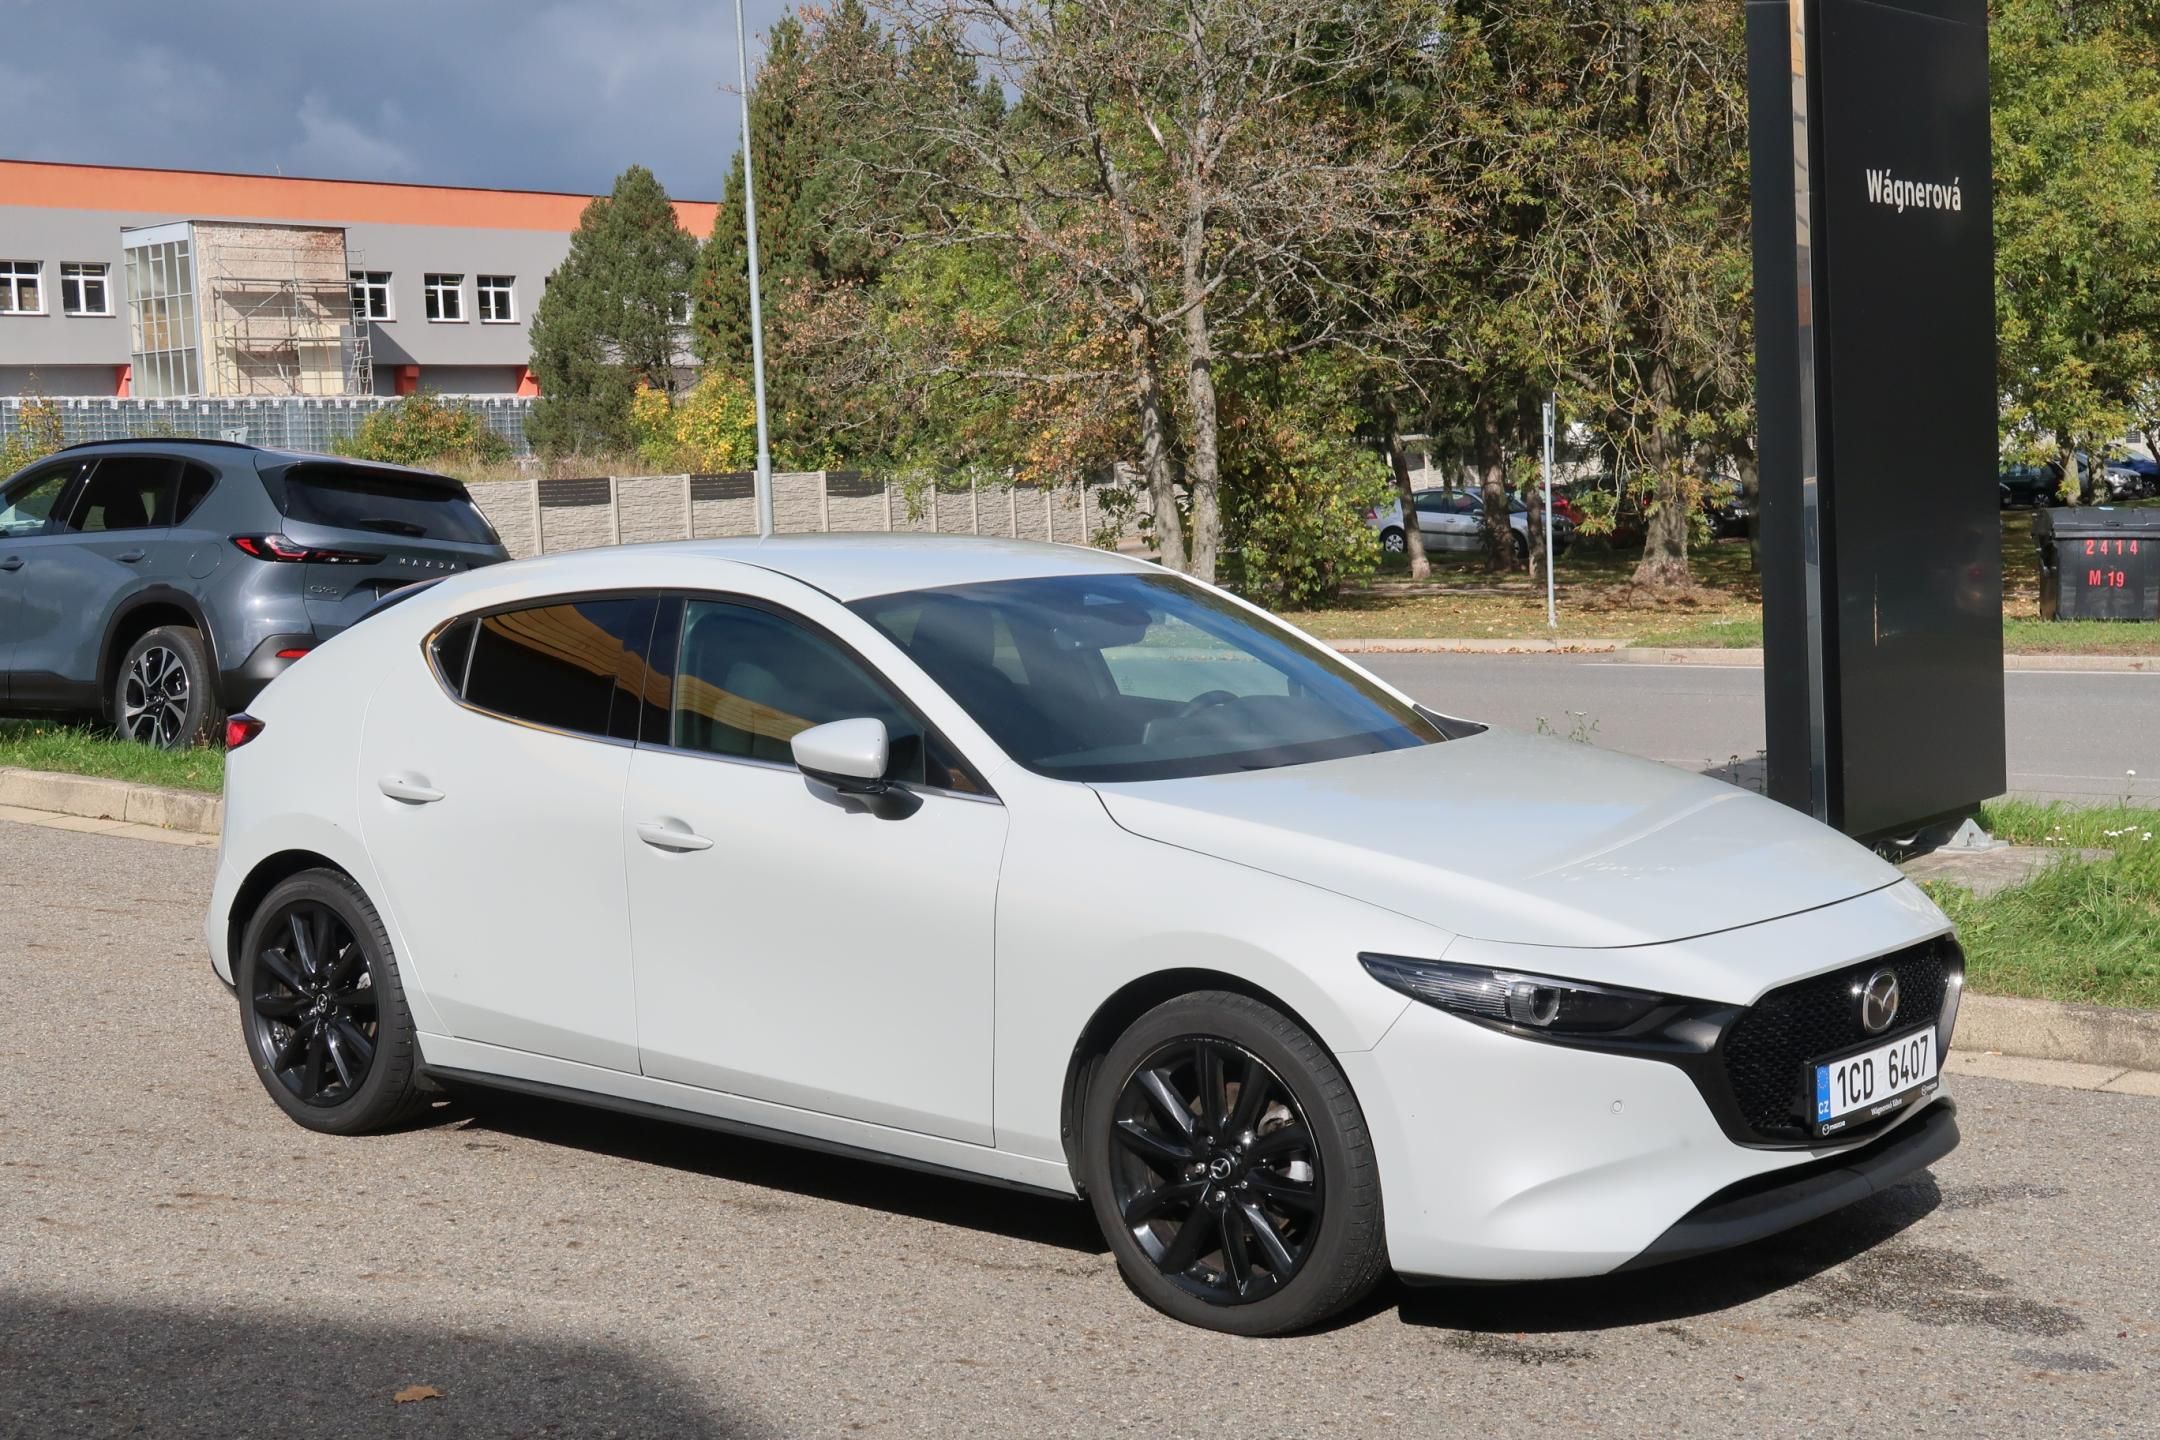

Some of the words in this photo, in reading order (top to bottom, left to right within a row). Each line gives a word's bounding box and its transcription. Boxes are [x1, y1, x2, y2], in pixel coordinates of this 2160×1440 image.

[1866, 168, 1961, 213] Wágnerová
[2086, 539, 2138, 555] 2414
[399, 557, 456, 570] MAZDA
[2089, 569, 2102, 586] M
[2108, 571, 2124, 587] 19
[1837, 1058, 1874, 1108] 1CD
[1888, 1035, 1928, 1089] 6407
[1818, 1101, 1829, 1114] CZ
